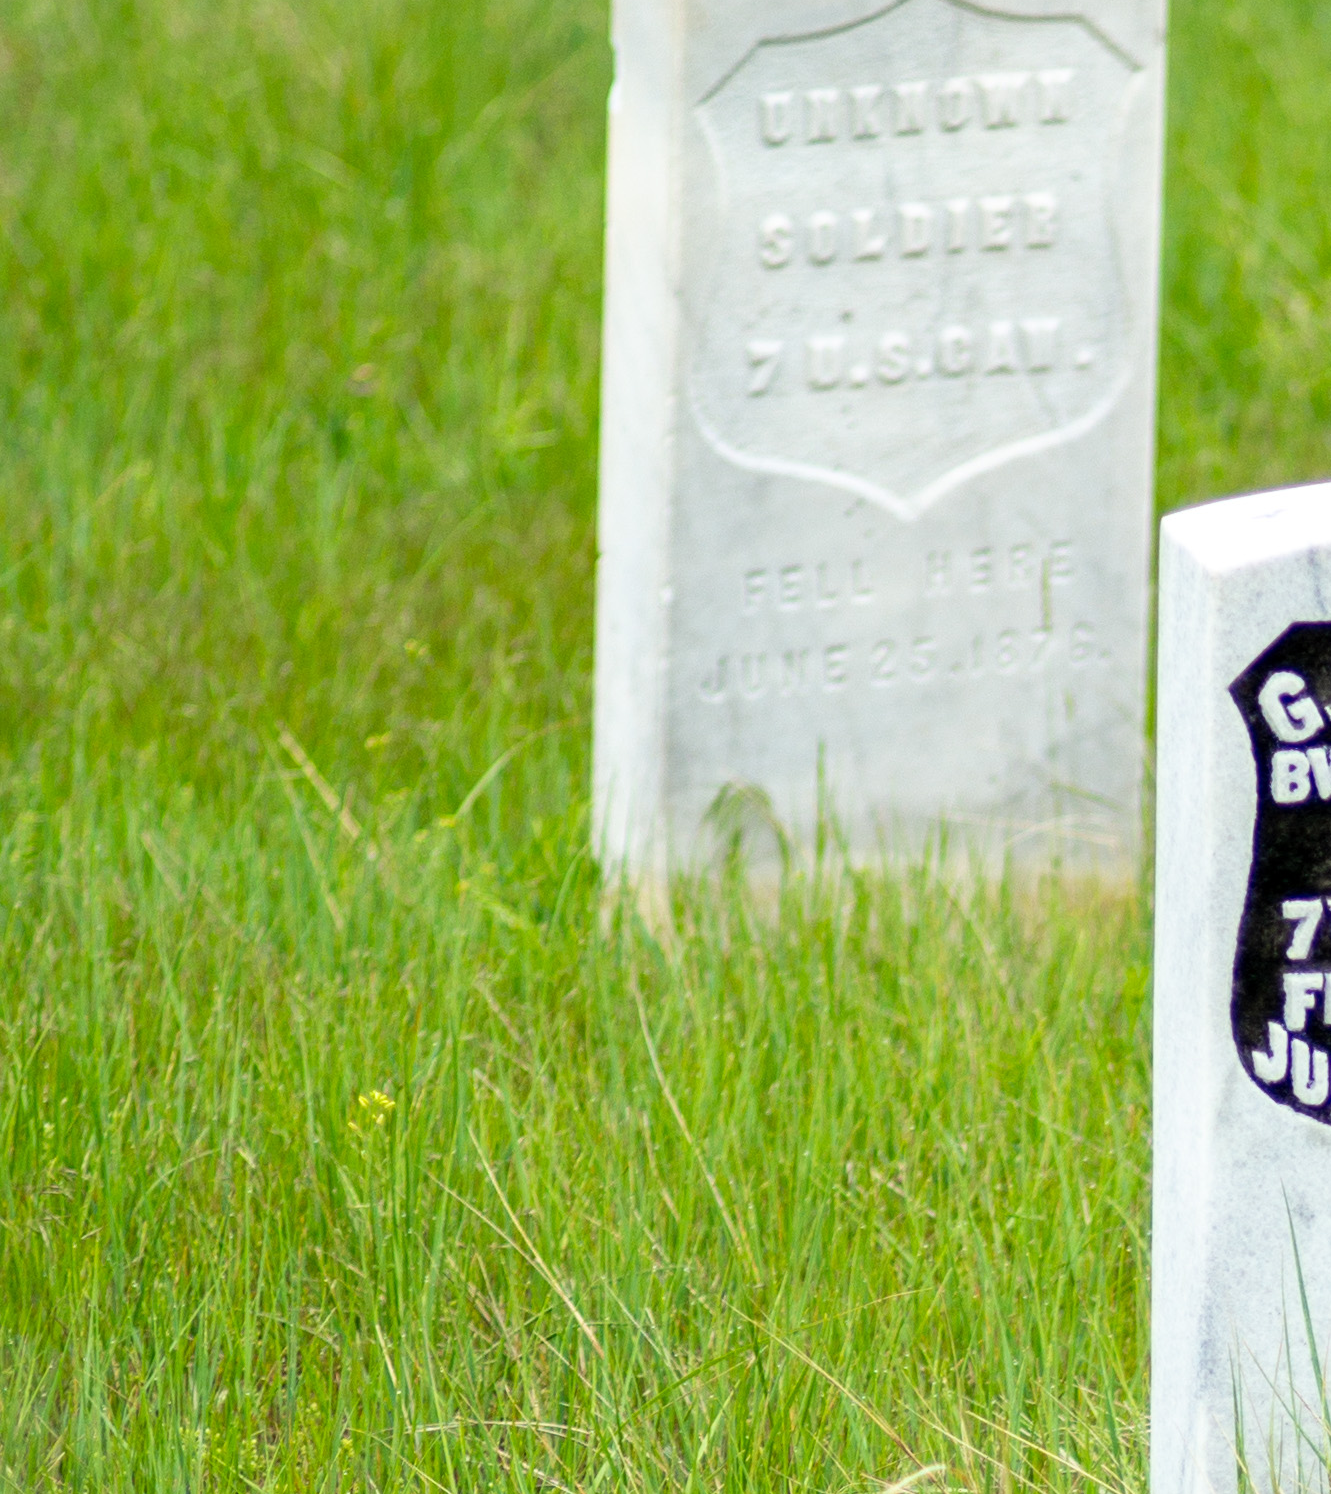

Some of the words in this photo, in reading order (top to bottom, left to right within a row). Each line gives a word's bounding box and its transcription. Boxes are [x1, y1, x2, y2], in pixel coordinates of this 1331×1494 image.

[759, 68, 1074, 147] UNKNOWN
[759, 191, 1058, 270] SOLDIER
[744, 339, 784, 398] 7
[743, 559, 874, 616] FELL
[925, 539, 1074, 596] HERE
[700, 643, 849, 704] JUNE
